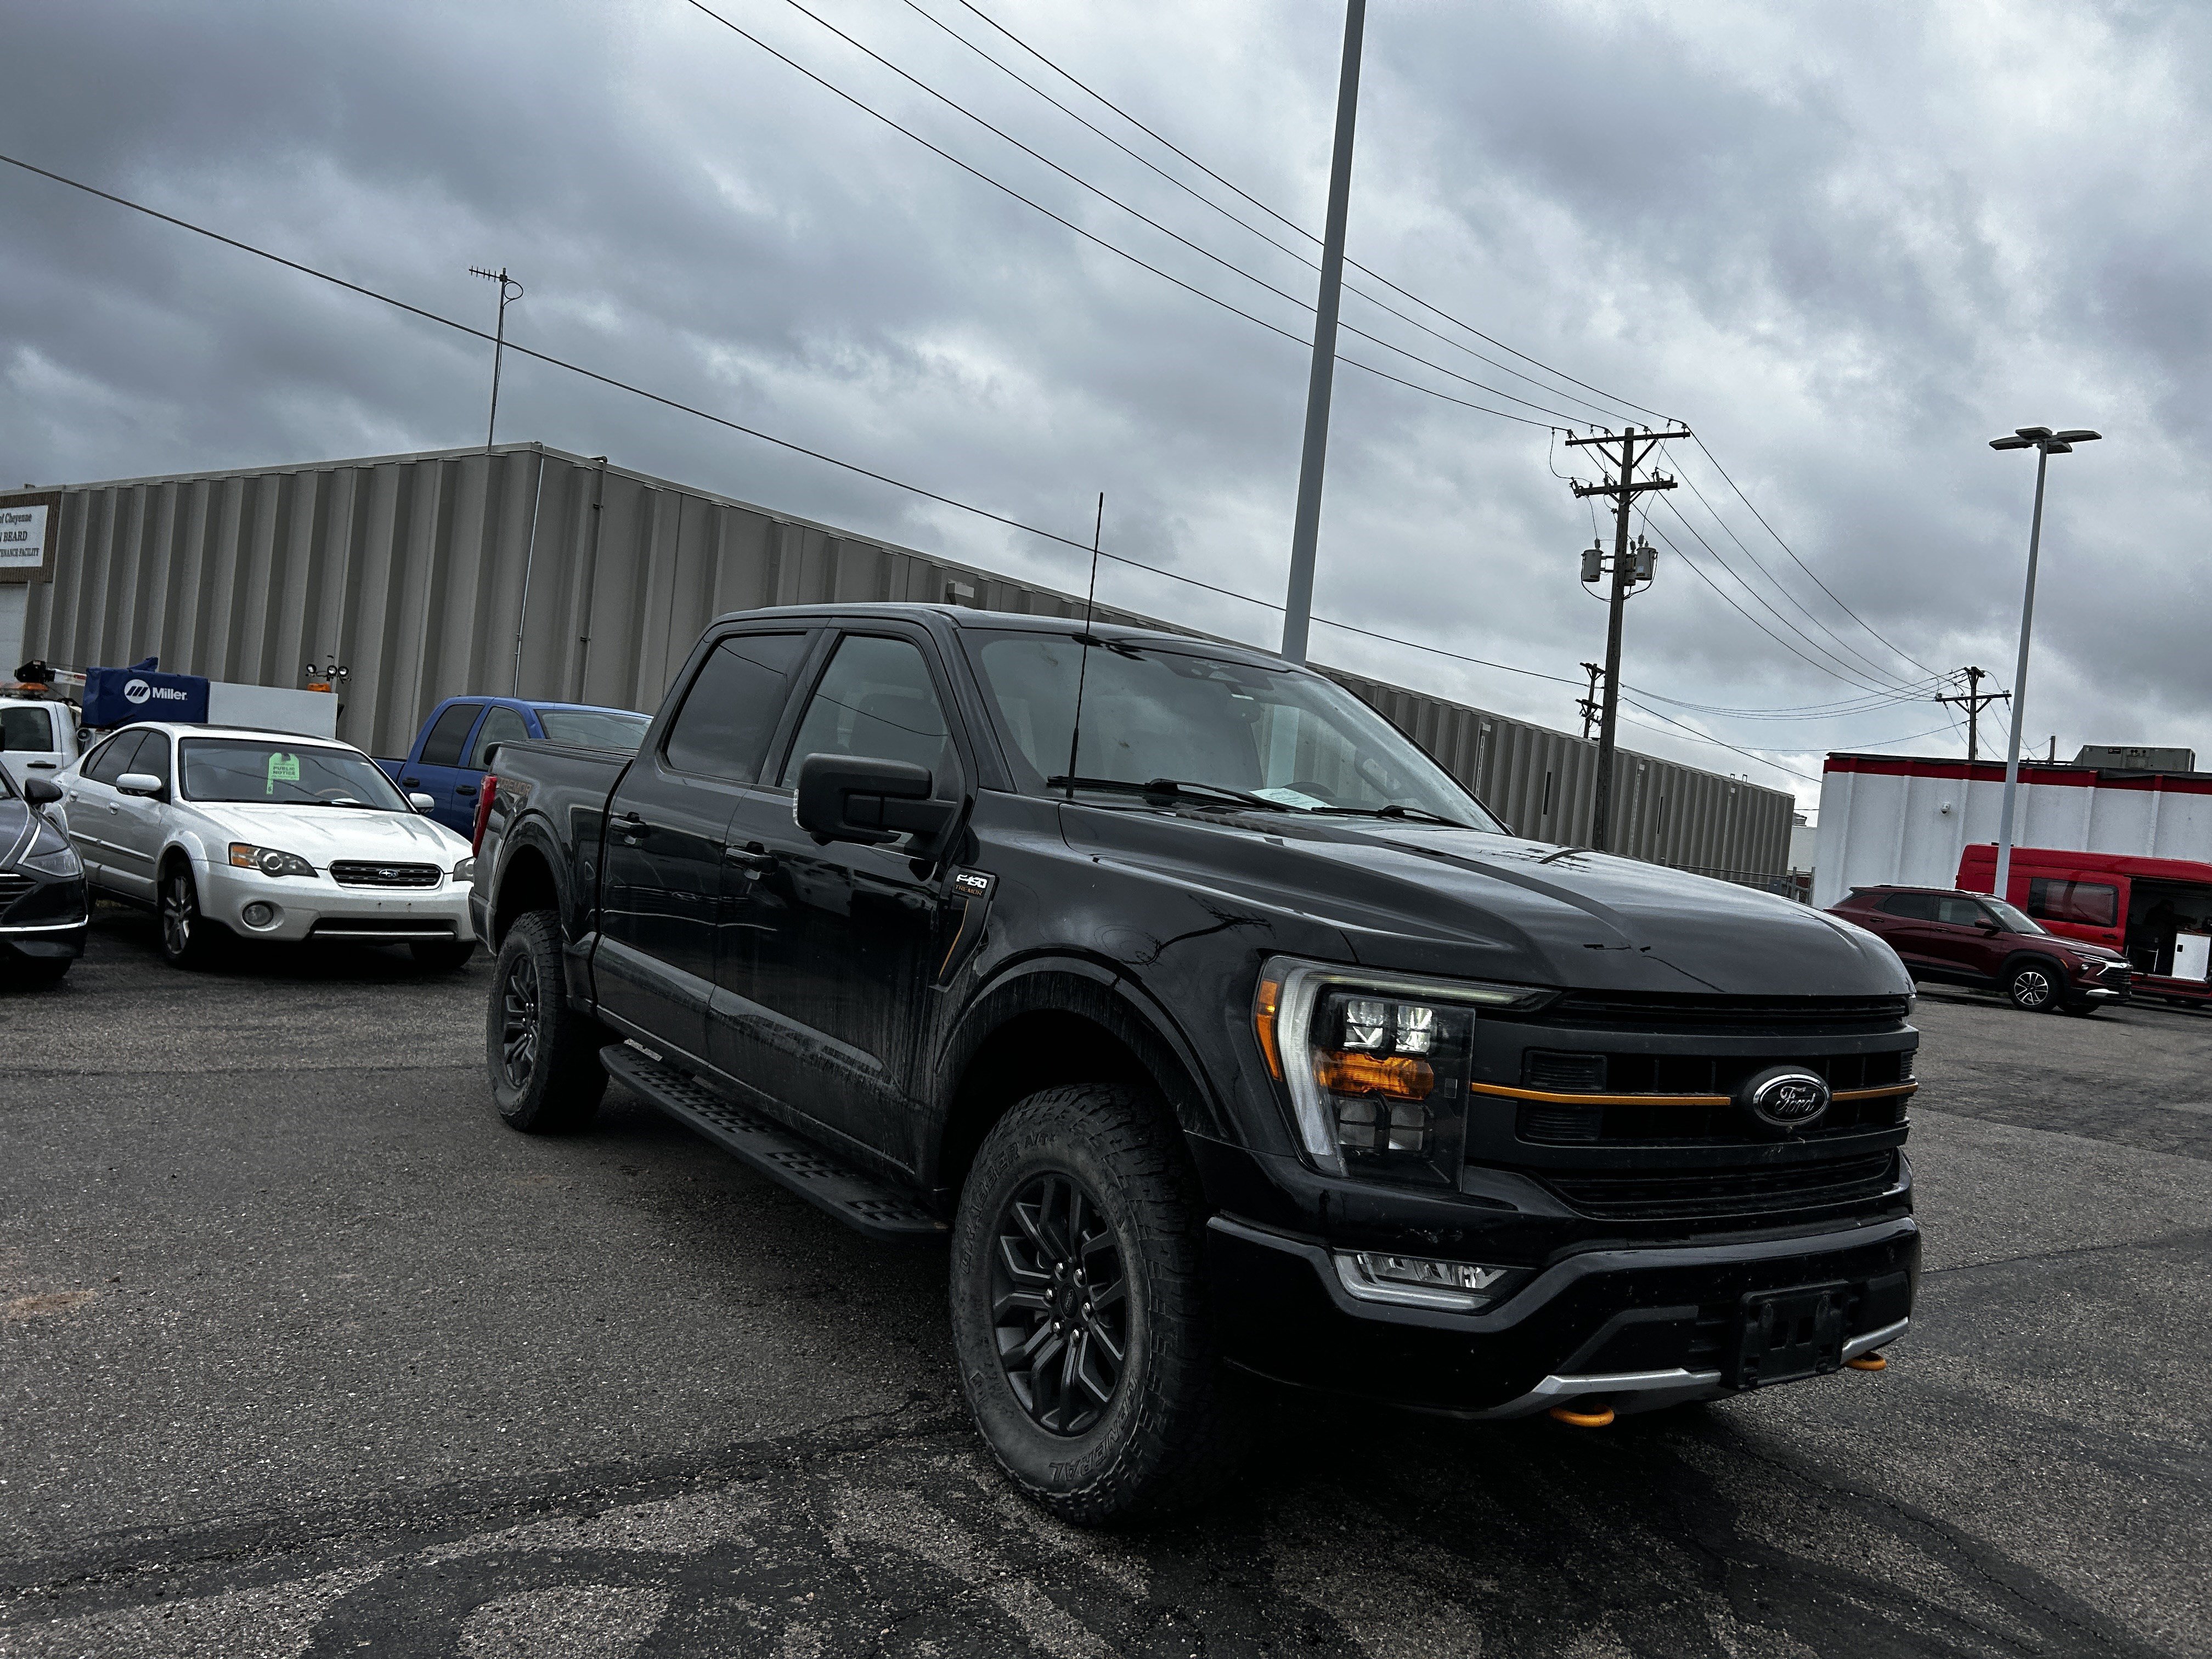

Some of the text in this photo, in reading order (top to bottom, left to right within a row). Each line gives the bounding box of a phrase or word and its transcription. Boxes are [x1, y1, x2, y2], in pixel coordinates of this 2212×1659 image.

[5, 512, 32, 525] Cheyenne
[3, 531, 27, 542] BEARD
[153, 687, 187, 701] Miller
[956, 874, 988, 889] F-150
[955, 884, 983, 896] TREMOR
[1774, 1086, 1816, 1114] Ford
[960, 1142, 1020, 1274] GRABBER
[1048, 1369, 1137, 1482] GENERAL
